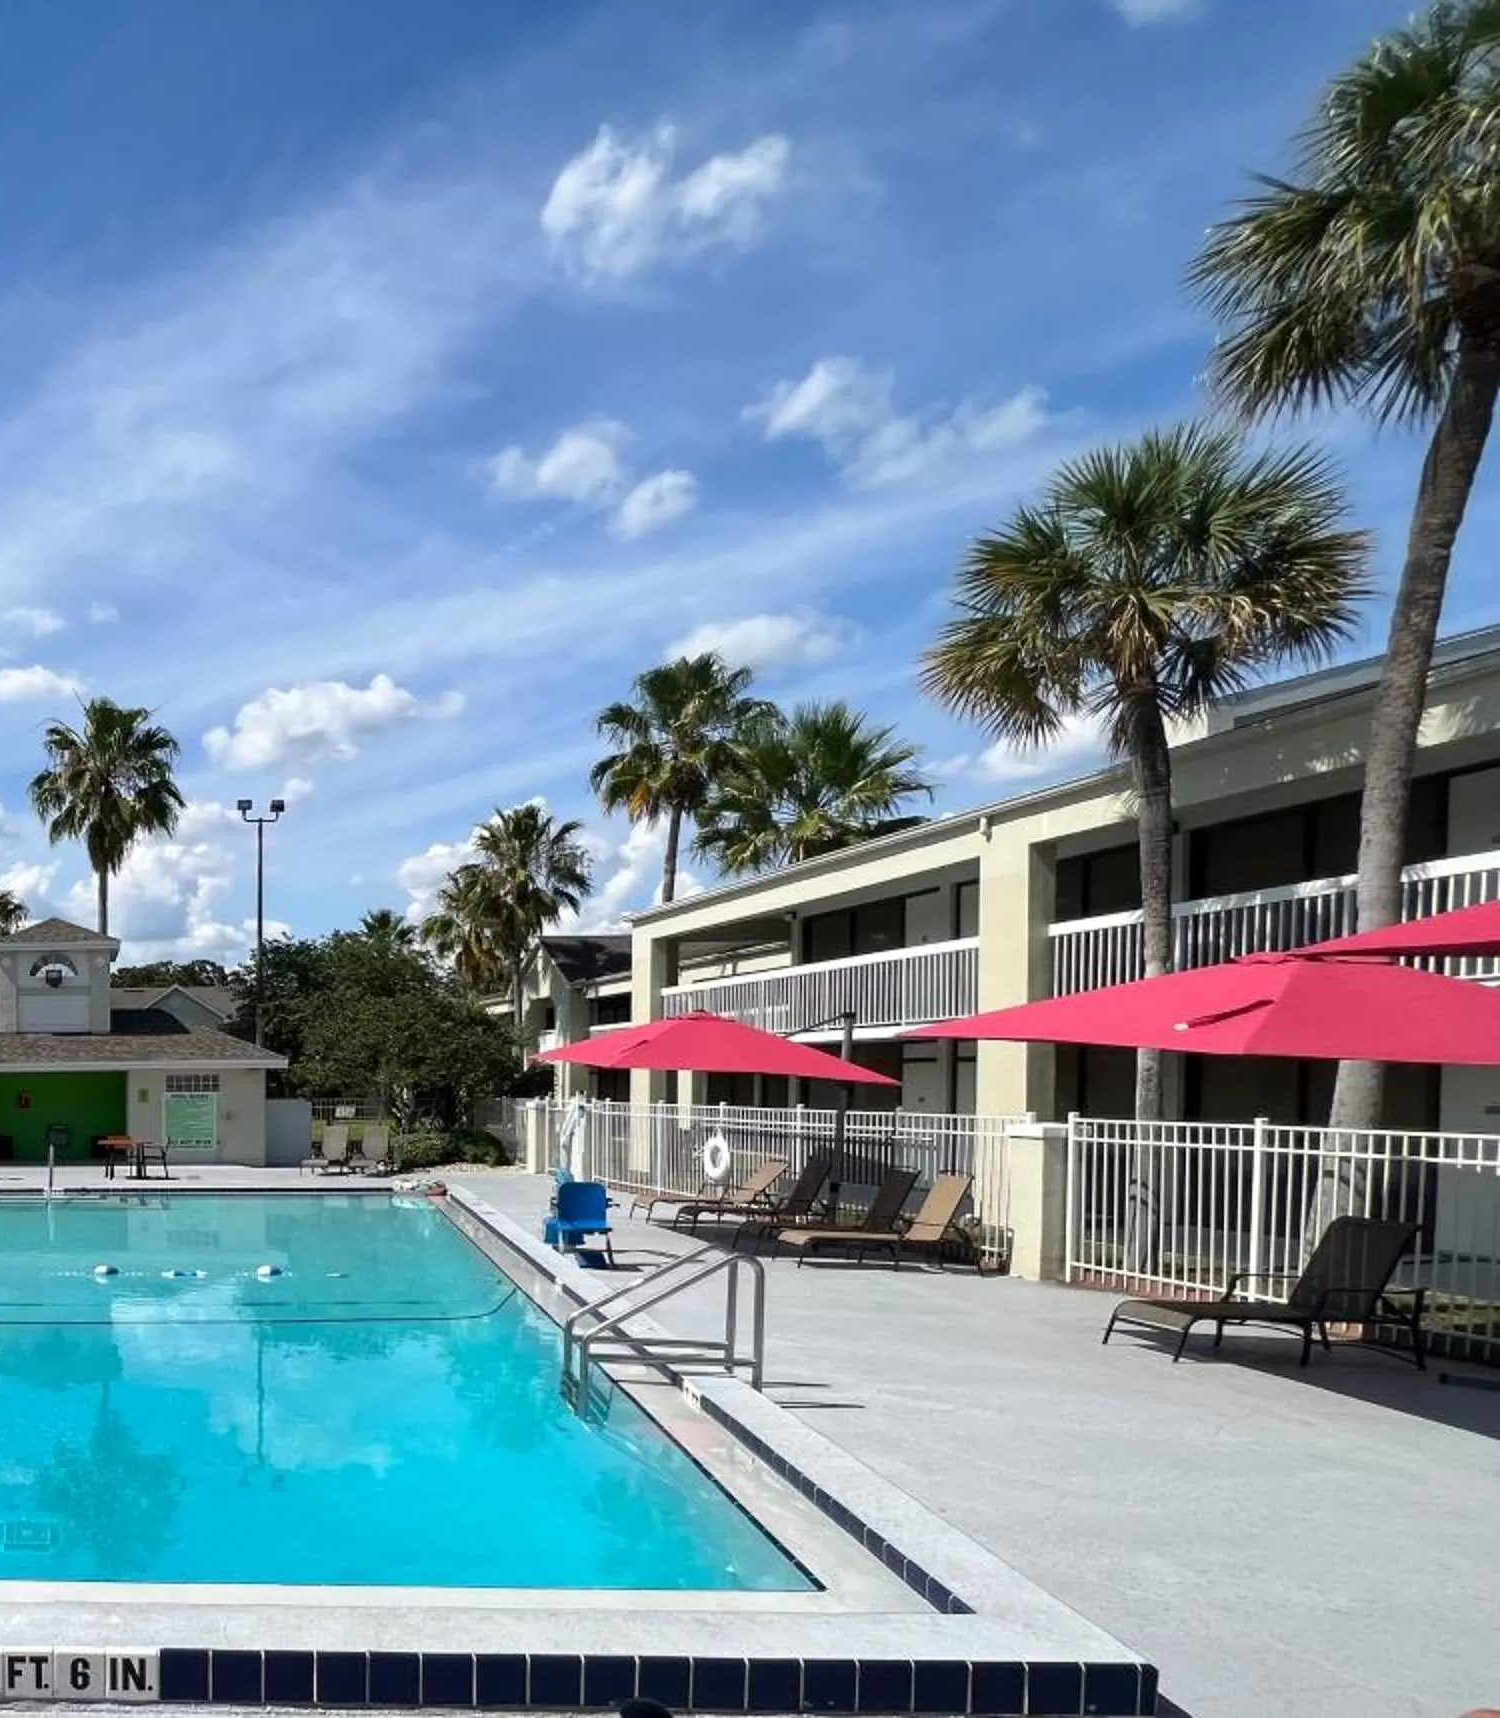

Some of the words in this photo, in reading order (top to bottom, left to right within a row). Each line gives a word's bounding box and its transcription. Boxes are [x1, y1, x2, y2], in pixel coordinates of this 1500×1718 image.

[7, 1655, 49, 1690] FT.
[69, 1657, 91, 1691] 6
[110, 1657, 153, 1692] IN.
